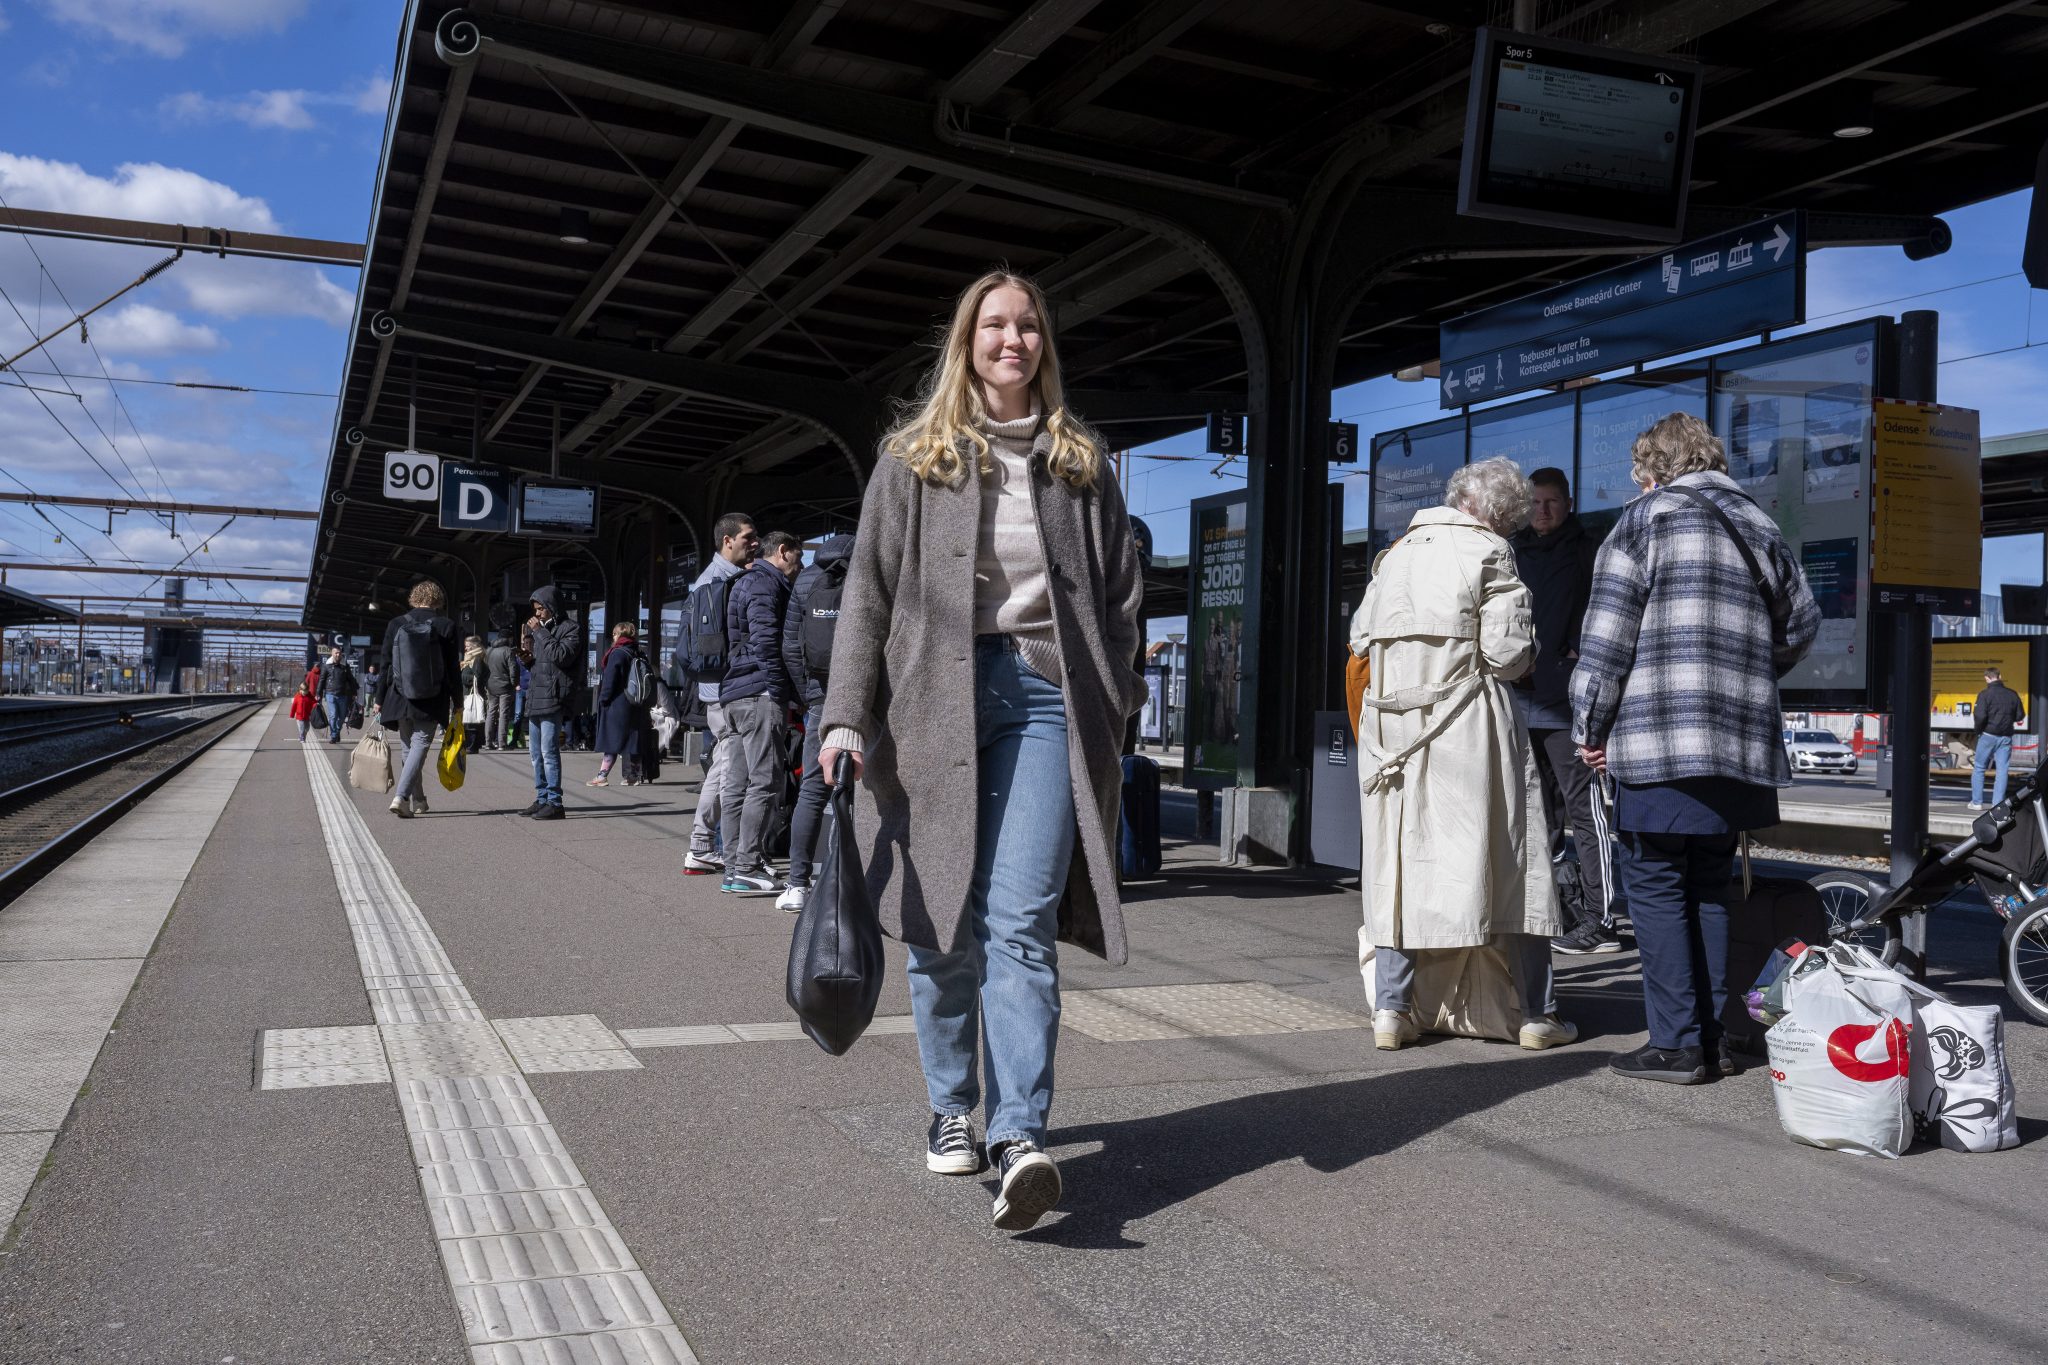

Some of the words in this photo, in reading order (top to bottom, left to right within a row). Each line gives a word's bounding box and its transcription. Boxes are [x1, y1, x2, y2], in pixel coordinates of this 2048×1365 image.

[1506, 45, 1525, 59] Spor
[1526, 48, 1533, 58] 5
[1544, 302, 1572, 317] Odense
[1574, 287, 1612, 308] Banegård
[1614, 280, 1642, 298] Center
[1519, 346, 1556, 364] Togbusser
[1558, 341, 1578, 354] kører
[1580, 336, 1590, 348] fra
[1519, 358, 1560, 376] Kottesgade
[1562, 353, 1574, 366] via
[1576, 348, 1599, 362] broen
[1726, 378, 1738, 388] DSB
[1593, 424, 1606, 437] Du
[1610, 420, 1638, 436] sparer
[1642, 416, 1654, 427] 10
[1884, 422, 1920, 434] Odense
[1929, 425, 1972, 440] København
[1220, 428, 1232, 447] 5
[1520, 440, 1526, 452] 5
[1336, 437, 1348, 456] 6
[390, 462, 434, 490] 90
[453, 466, 499, 477] Perronafsnit
[1385, 472, 1401, 483] Hold
[1402, 466, 1424, 479] afstand
[1430, 480, 1441, 490] når
[1592, 478, 1607, 490] fra
[458, 482, 493, 520] D
[1384, 502, 1402, 513] toget
[1402, 498, 1420, 510] kører
[1429, 496, 1438, 506] og
[1204, 544, 1212, 552] OM
[1213, 542, 1220, 552] AT
[1220, 540, 1238, 550] FINDE
[1204, 554, 1215, 564] DER
[1216, 552, 1236, 563] TAGER
[334, 634, 344, 646] C
[1770, 1068, 1786, 1082] oop
